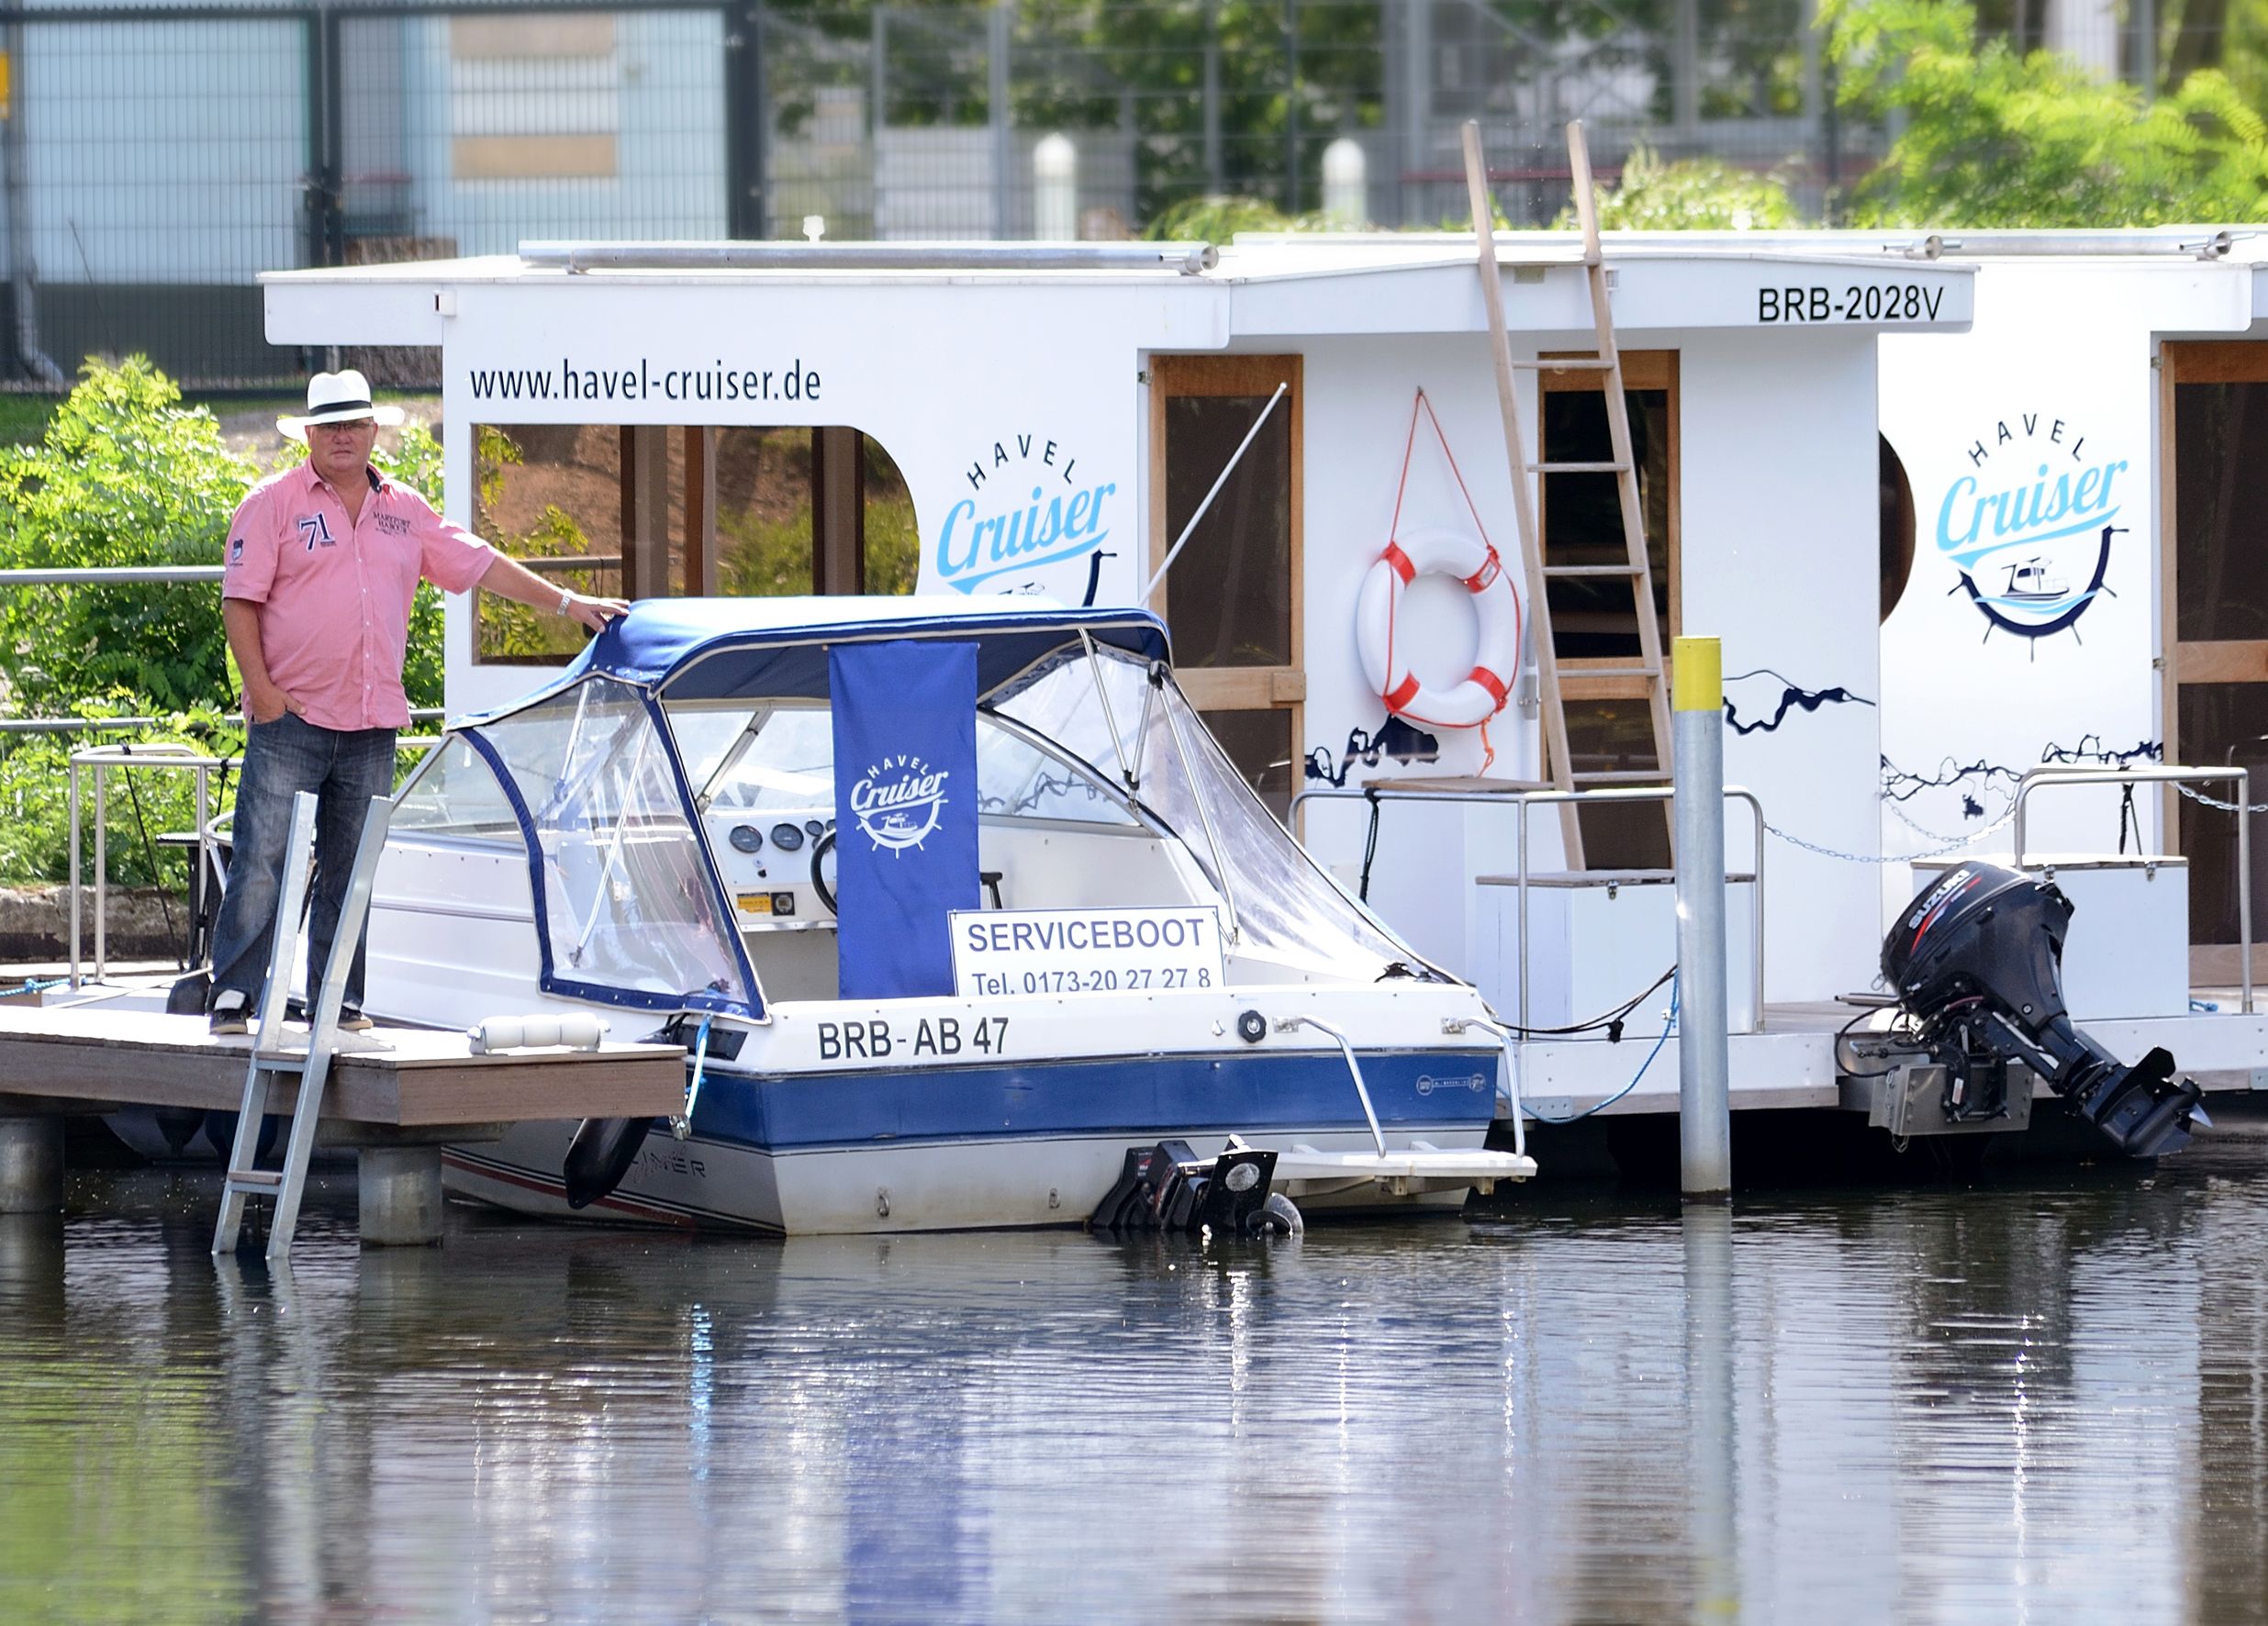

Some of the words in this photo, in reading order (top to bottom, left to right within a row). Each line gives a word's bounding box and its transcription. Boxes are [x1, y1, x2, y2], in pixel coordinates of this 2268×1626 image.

[1759, 285, 1944, 322] BRB-2028V
[470, 358, 821, 400] www.havel-cruiser.de
[1968, 413, 2084, 468] HAVEL
[966, 434, 1076, 491] HAVEL
[1936, 460, 2128, 551] Cruiser
[298, 511, 336, 552] 71
[936, 483, 1116, 577] Cruiser
[867, 754, 929, 778] HAVEL
[850, 771, 949, 813] Cruiser
[1908, 869, 1971, 930] SUZUKI
[968, 919, 1204, 952] SERVICEBOOT
[972, 972, 1015, 997] Tel.
[1022, 969, 1118, 994] 0173-20
[1125, 969, 1153, 989] 27
[1161, 968, 1189, 988] 27
[1197, 967, 1212, 988] 8
[973, 1017, 1010, 1054] 47
